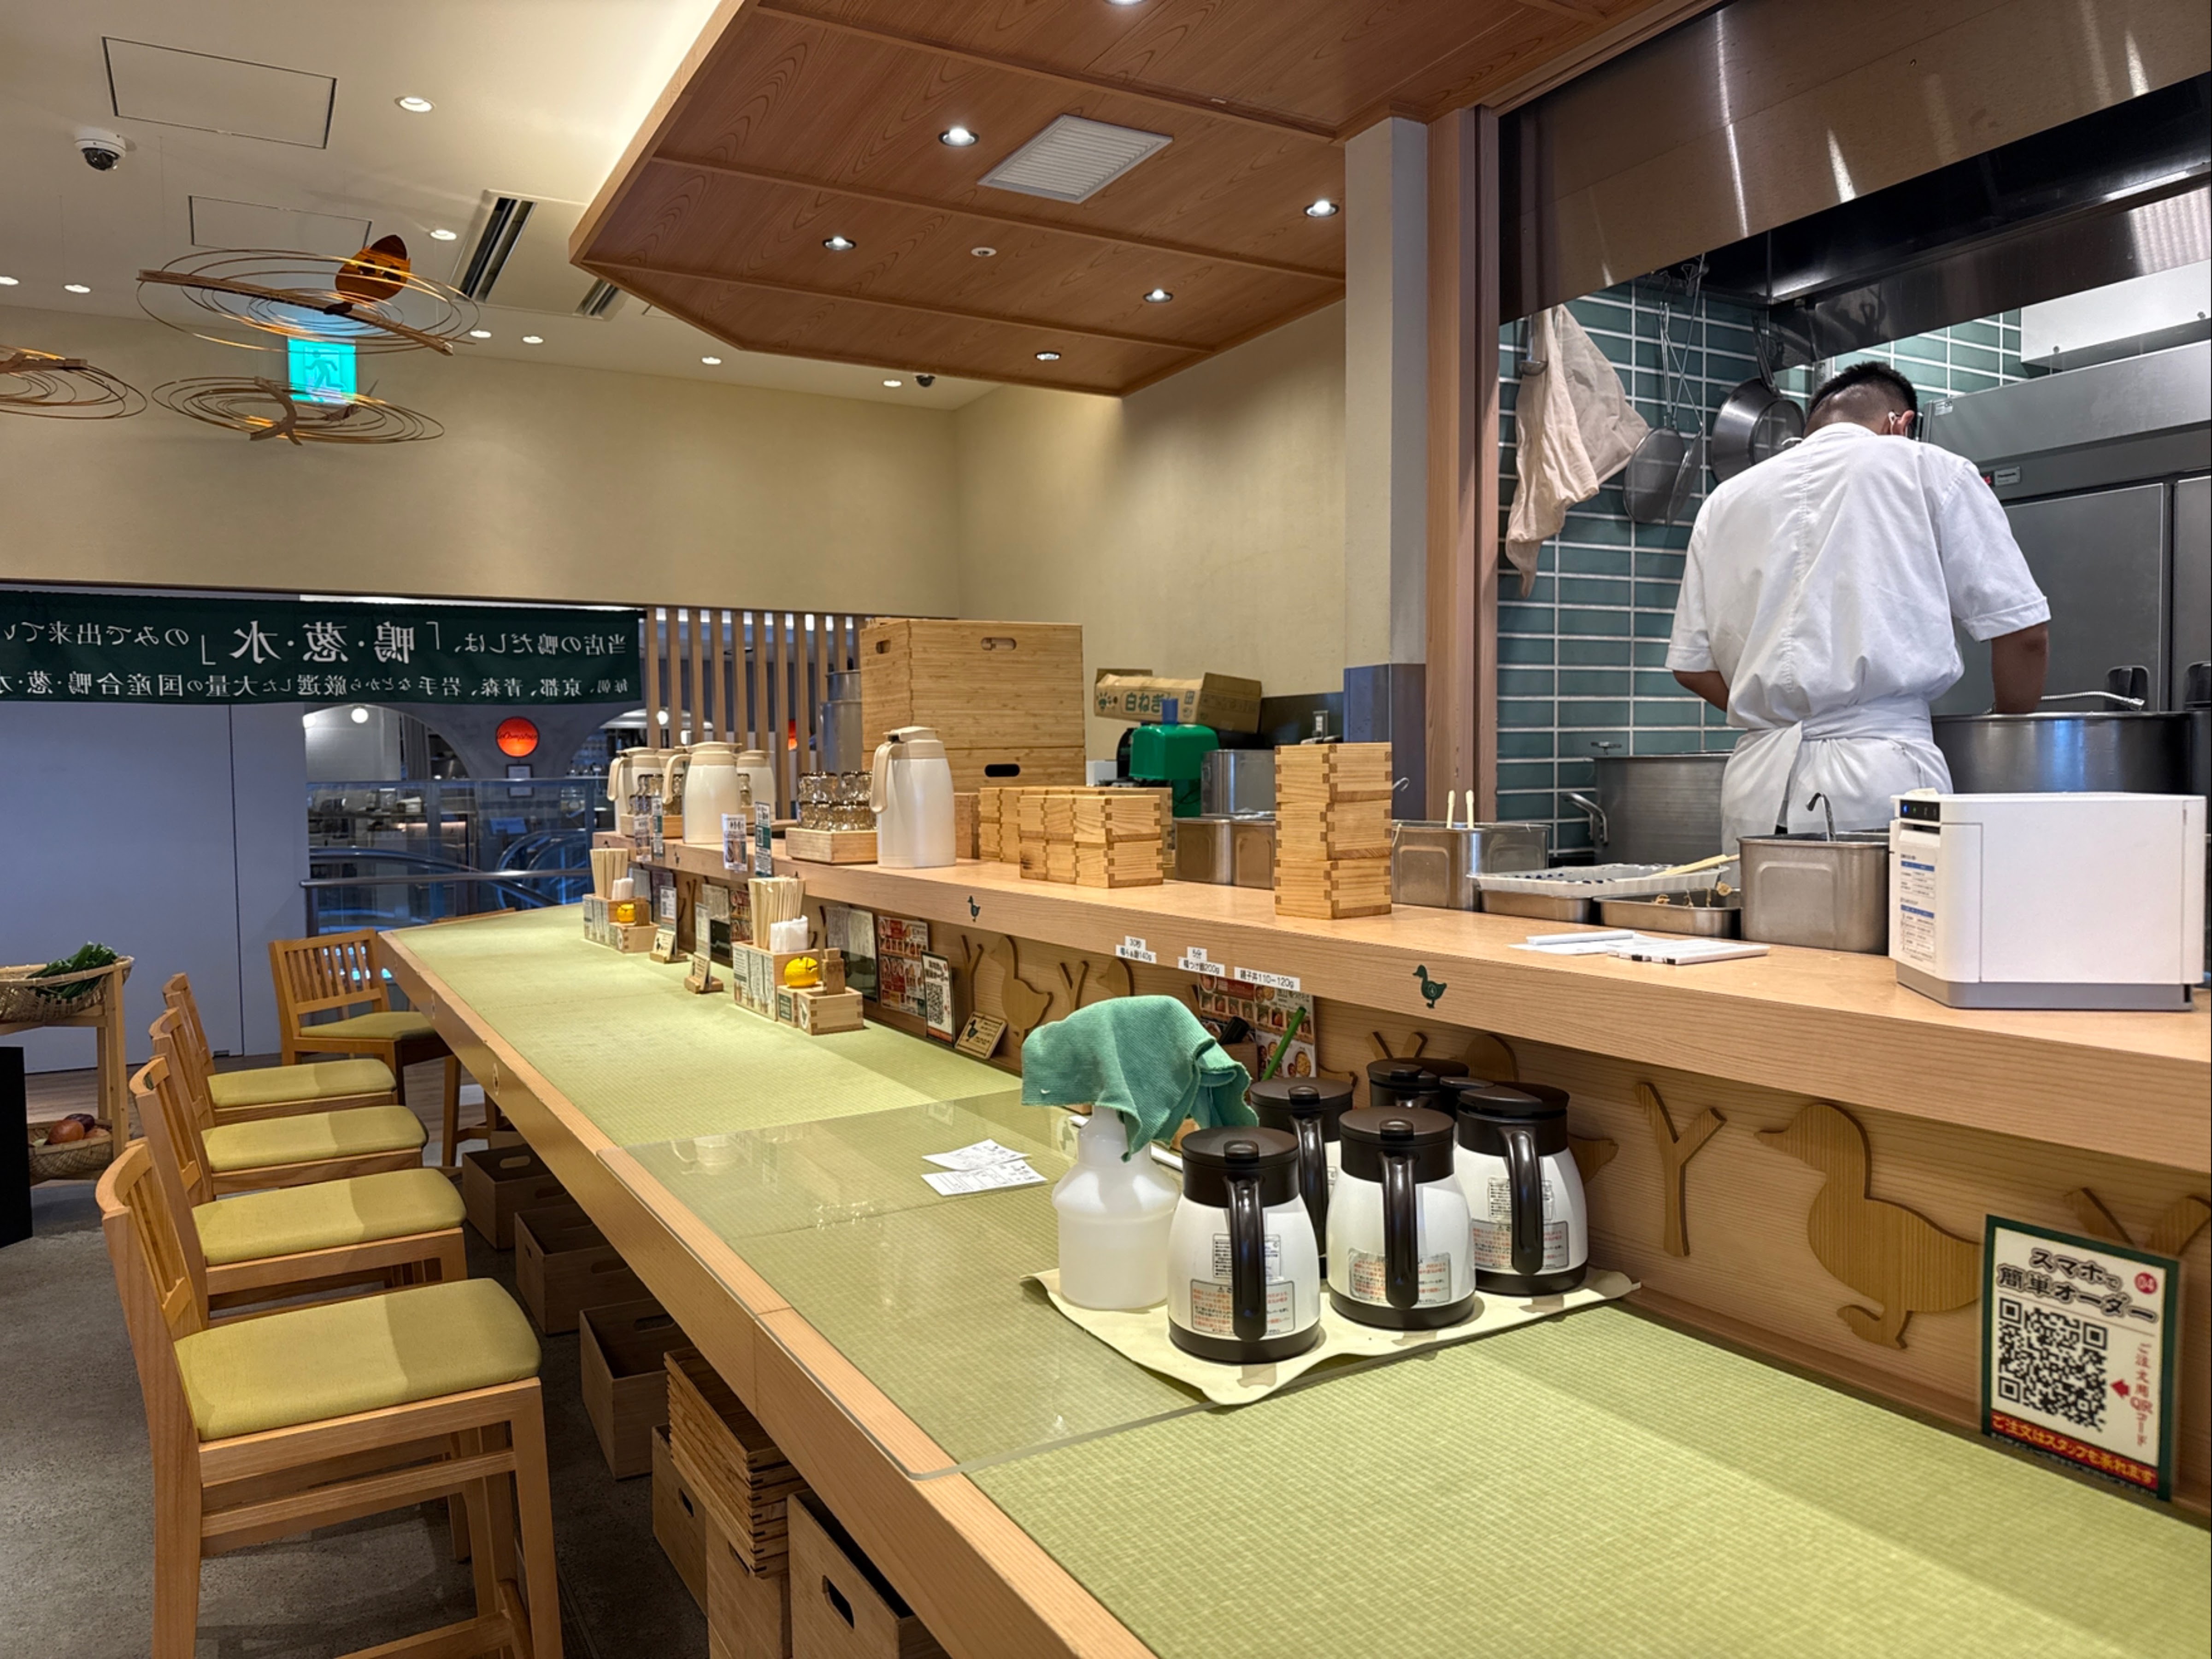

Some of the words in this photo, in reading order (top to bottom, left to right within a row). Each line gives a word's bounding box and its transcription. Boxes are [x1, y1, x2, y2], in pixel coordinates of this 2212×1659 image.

[1999, 1265, 2158, 1321] 簡単オーダー
[2030, 1249, 2121, 1289] スマホで
